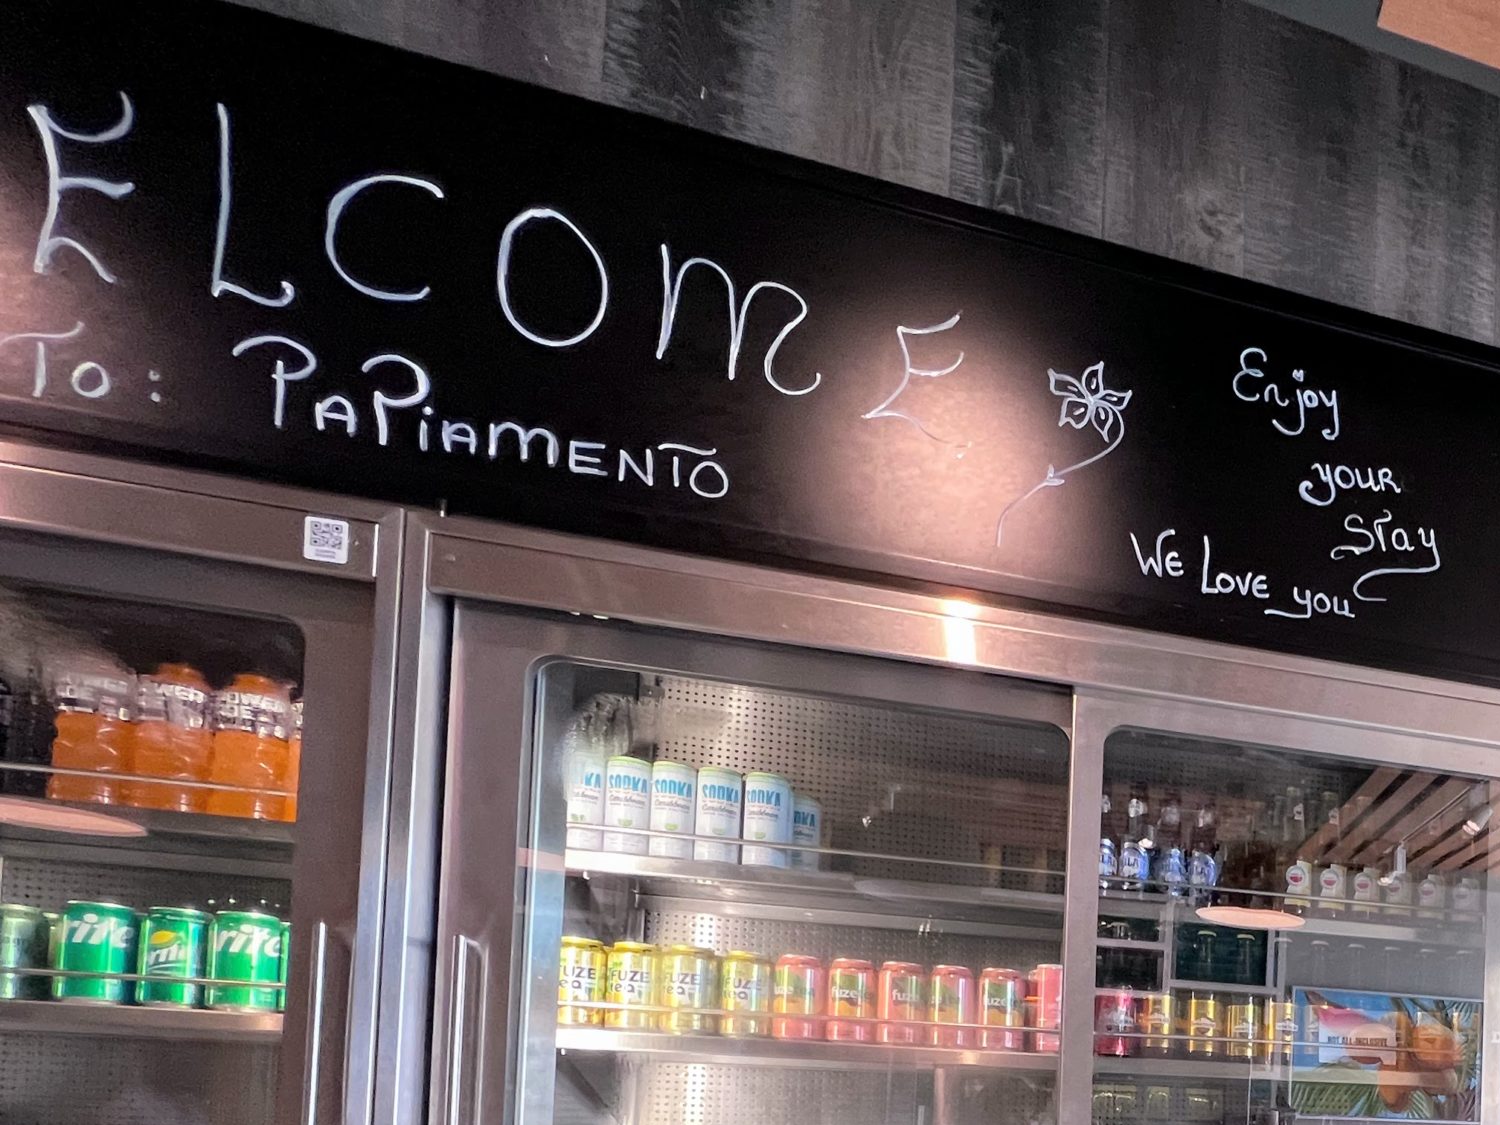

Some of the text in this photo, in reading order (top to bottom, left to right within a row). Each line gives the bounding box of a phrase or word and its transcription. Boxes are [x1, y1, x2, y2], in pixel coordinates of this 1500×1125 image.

[1232, 347, 1339, 440] Enjoy
[1331, 510, 1441, 601] Stay
[560, 966, 597, 980] UZE
